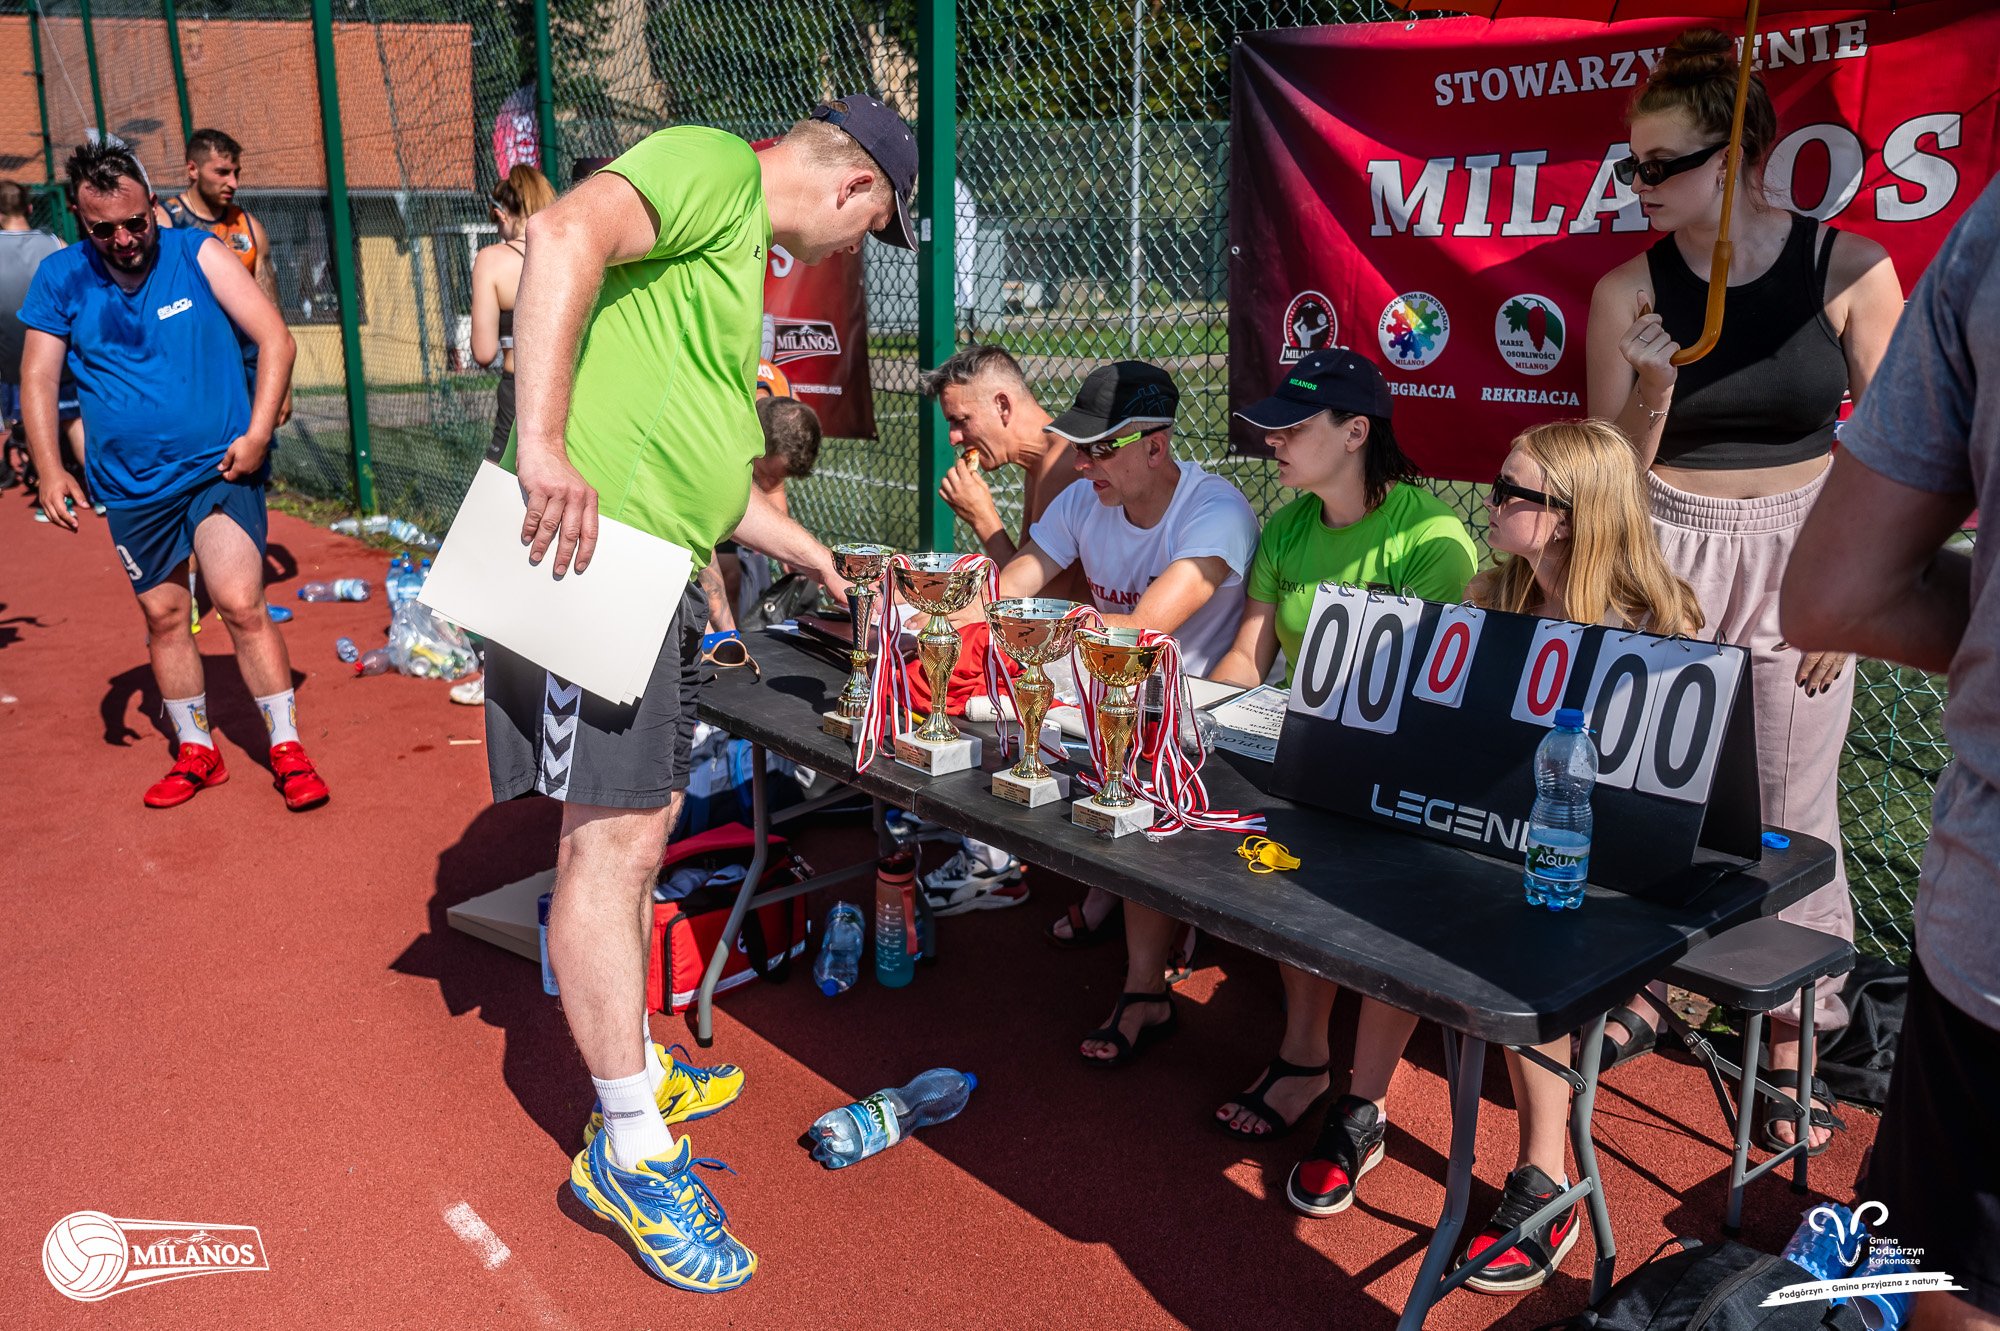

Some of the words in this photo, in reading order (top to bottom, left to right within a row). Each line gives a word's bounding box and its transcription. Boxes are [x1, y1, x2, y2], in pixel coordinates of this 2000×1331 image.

[1435, 19, 1868, 106] STOWARZYENIE
[1366, 112, 1963, 238] MILAOS
[777, 335, 835, 350] MILANOS
[1500, 339, 1524, 347] MARSZ
[1395, 358, 1425, 366] MILANOS
[1506, 350, 1556, 360] OSOBLIWOŚCI
[1515, 362, 1549, 371] MILANOS
[1289, 378, 1317, 391] MILANOS
[1386, 382, 1456, 399] EGRACJA
[1481, 387, 1580, 405] REKREACJA
[1536, 853, 1578, 869] AQUA
[859, 1099, 883, 1133] AQUA
